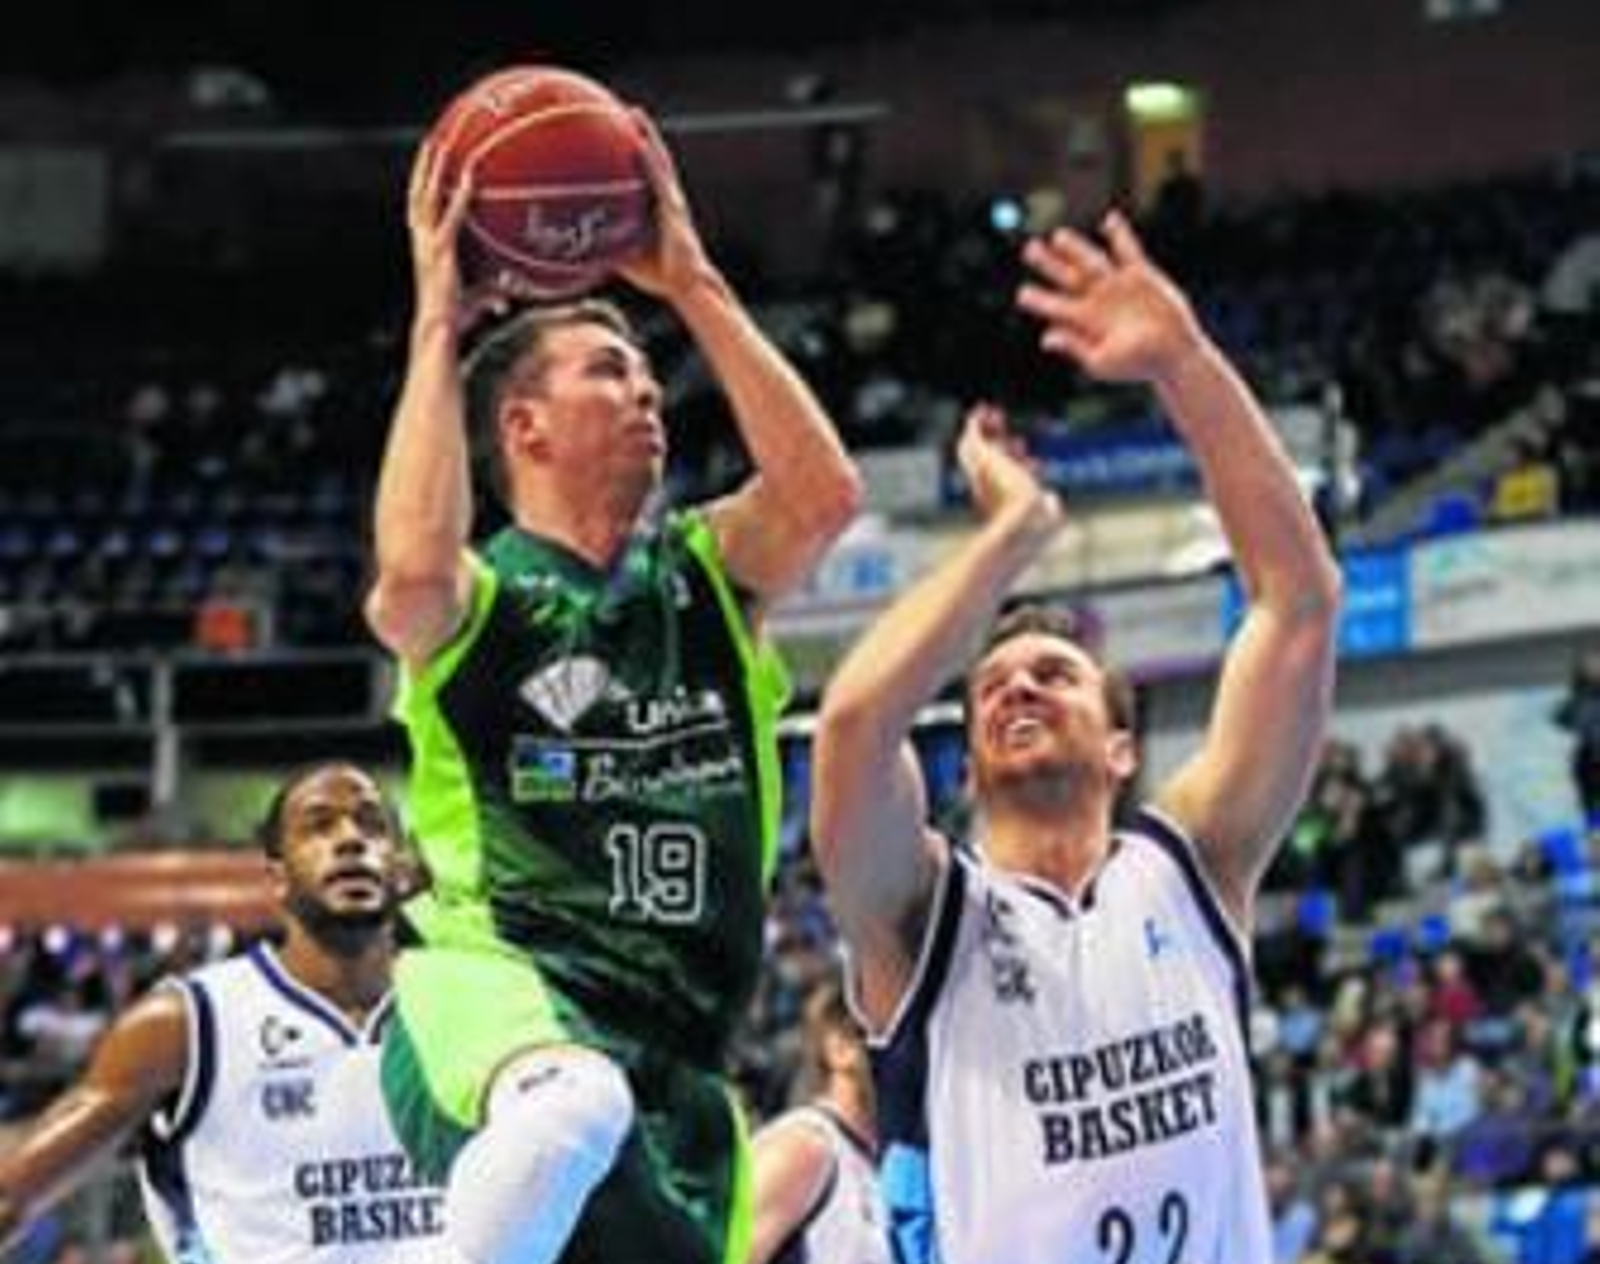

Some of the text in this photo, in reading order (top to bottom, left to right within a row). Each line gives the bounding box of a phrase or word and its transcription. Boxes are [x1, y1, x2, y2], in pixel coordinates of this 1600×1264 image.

[607, 824, 703, 922] 19
[1040, 1071, 1217, 1164] BASKET
[294, 1153, 408, 1199] GIPUZ
[310, 1196, 445, 1247] BASKE
